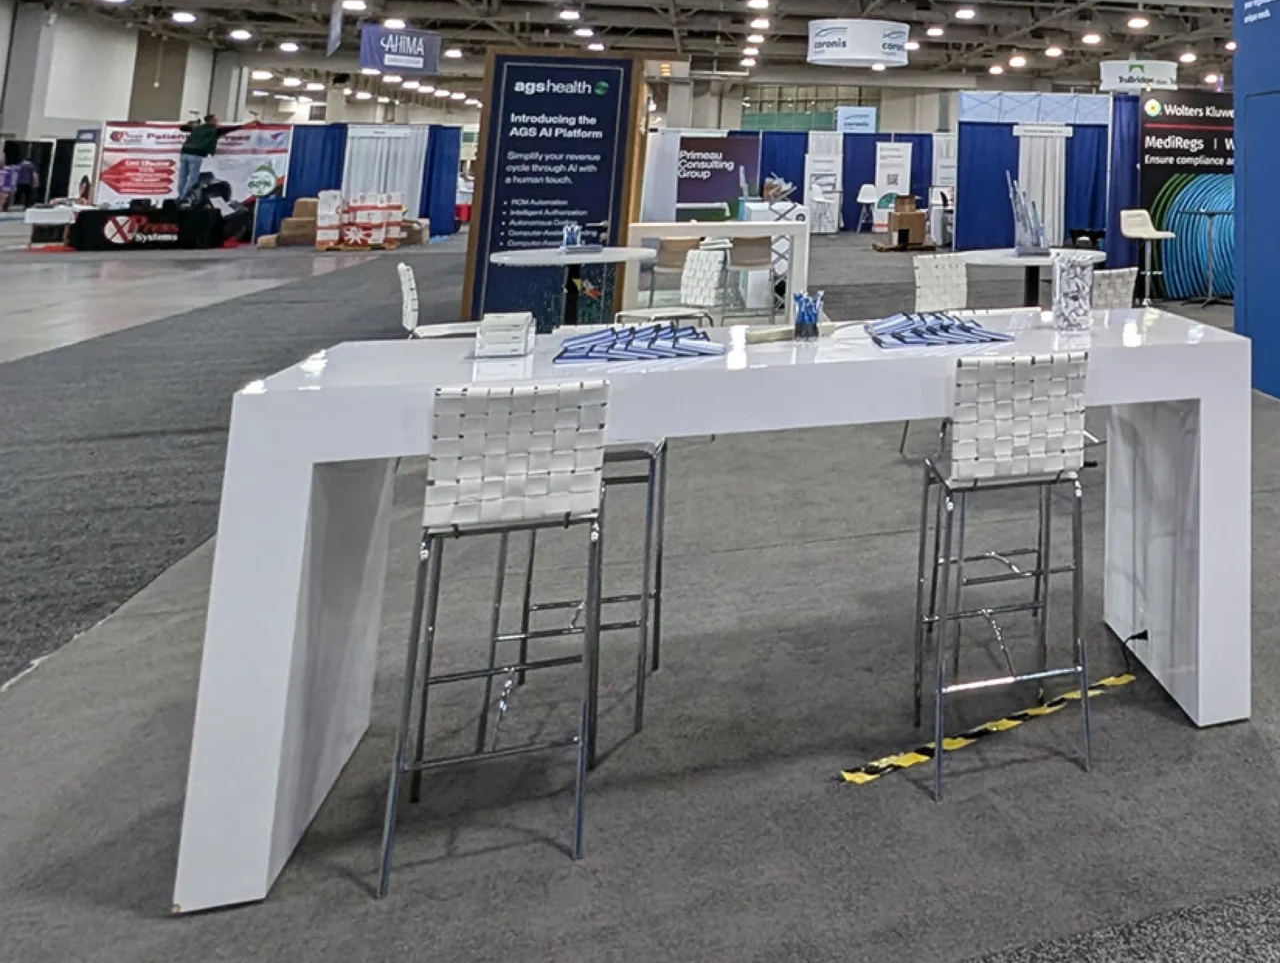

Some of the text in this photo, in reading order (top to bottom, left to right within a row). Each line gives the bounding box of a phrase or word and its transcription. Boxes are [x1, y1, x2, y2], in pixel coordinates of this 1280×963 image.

[1163, 104, 1204, 116] Wolters
[510, 113, 596, 126] Introducing the
[509, 127, 603, 139] AGS AI Platform
[1144, 135, 1204, 153] MediRegs
[507, 150, 600, 162] Simplify your revenue
[679, 150, 723, 160] Primeau
[1144, 154, 1174, 165] Ensure
[1176, 155, 1224, 166] compliance
[506, 163, 597, 174] cycle through AI with
[679, 160, 734, 171] Consulting
[678, 169, 711, 179] Group
[513, 176, 543, 184] human
[544, 176, 573, 185] touch.
